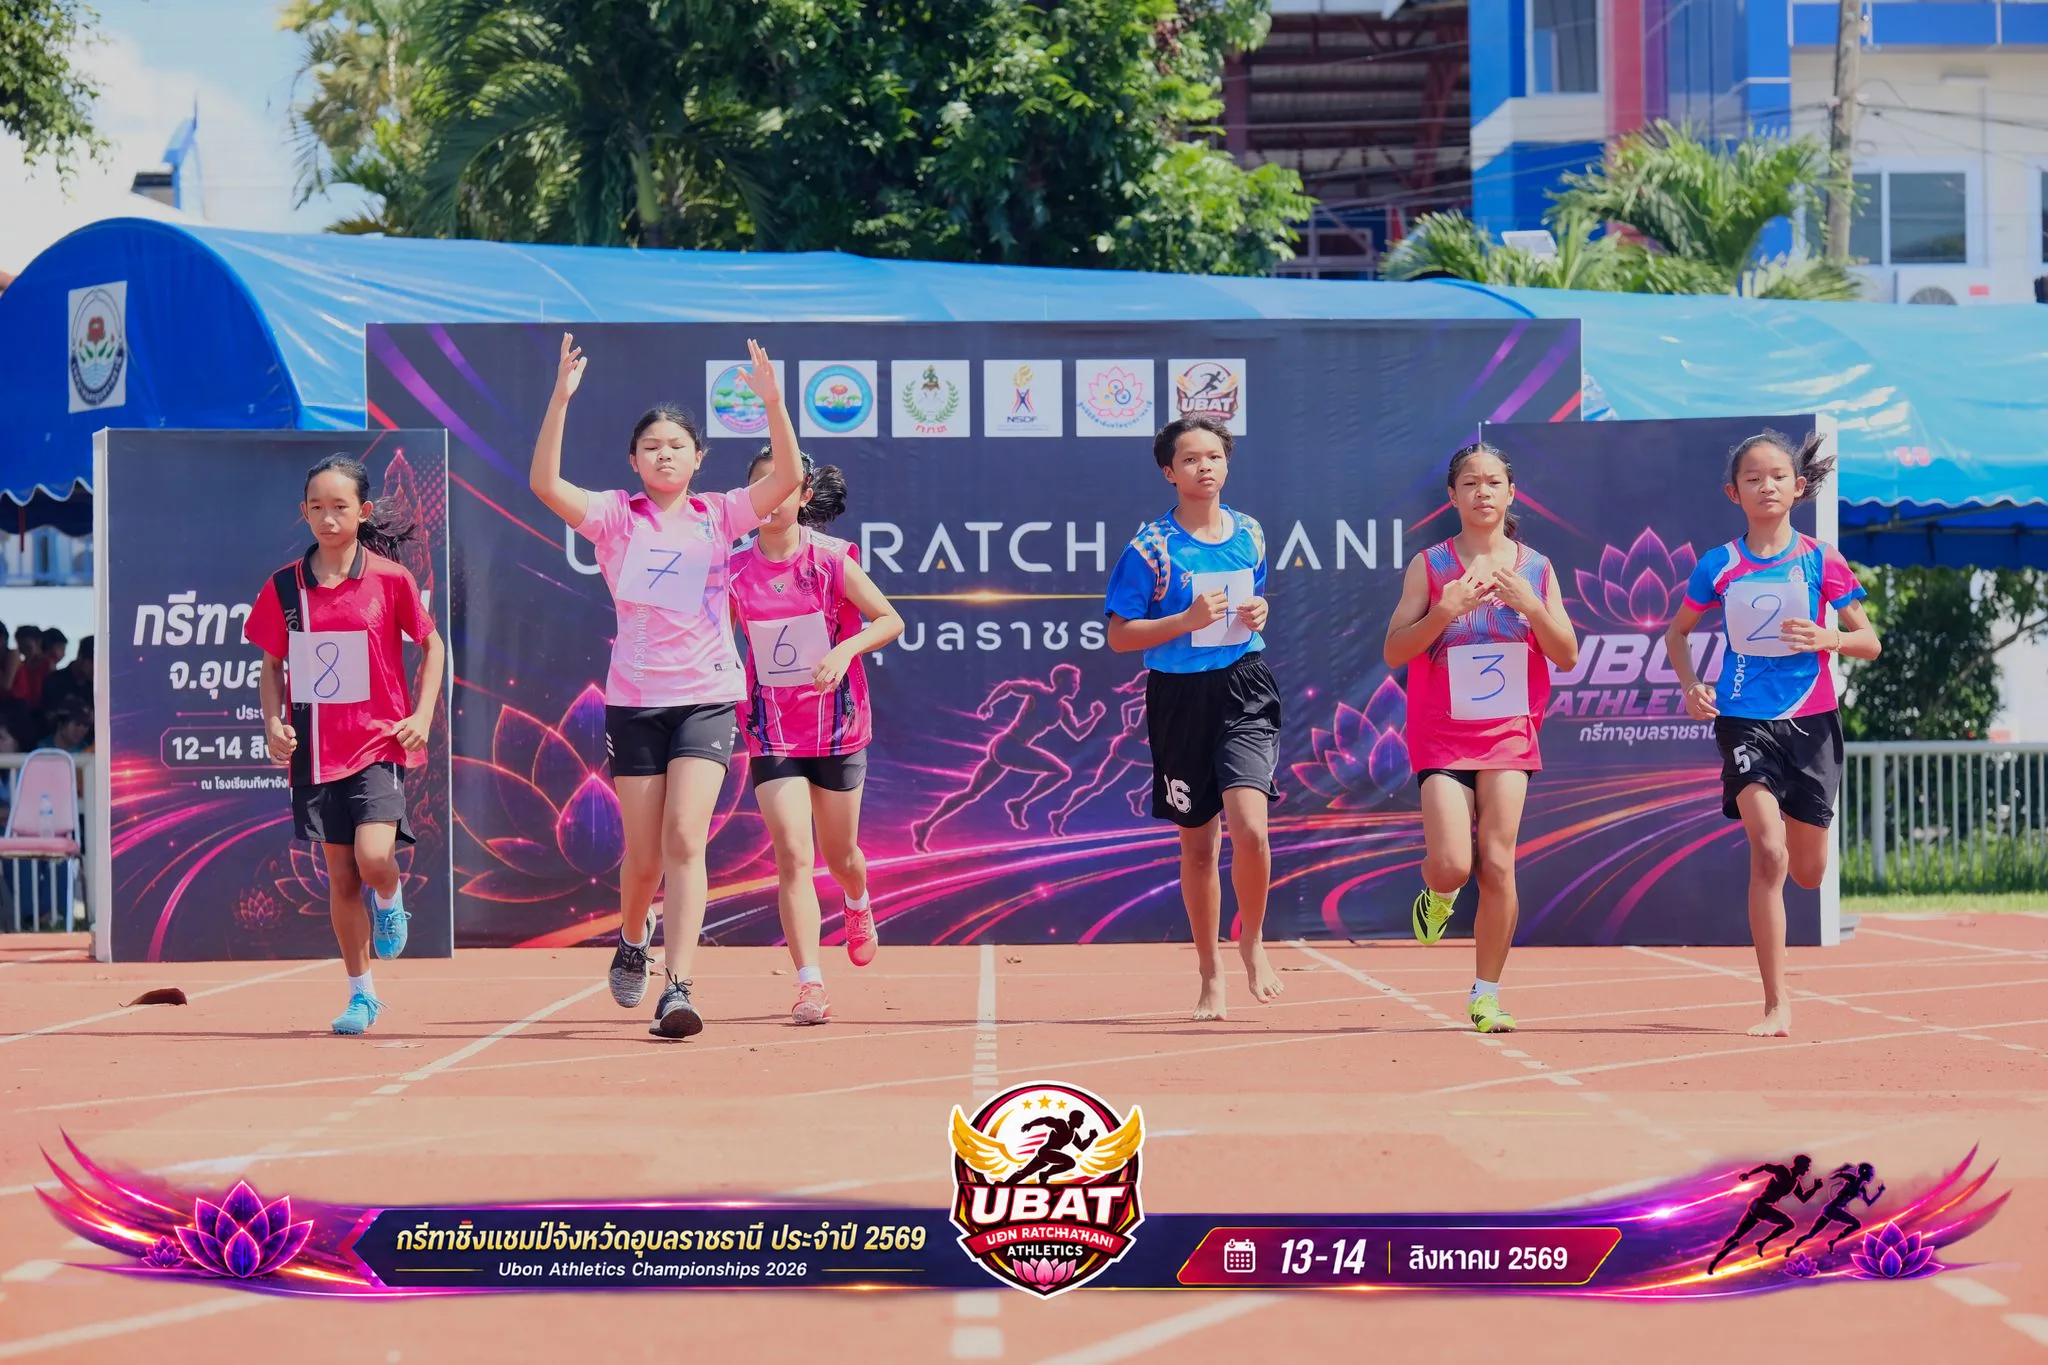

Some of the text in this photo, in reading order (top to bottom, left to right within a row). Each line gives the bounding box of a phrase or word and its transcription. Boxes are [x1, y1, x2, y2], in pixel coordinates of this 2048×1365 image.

[1181, 397, 1235, 412] UBAT
[647, 548, 682, 589] 7
[1746, 594, 1782, 642] 2
[773, 625, 798, 668] 6
[313, 641, 341, 698] 8
[1472, 654, 1506, 701] 3
[1729, 654, 1747, 700] CHOOL
[1733, 744, 1751, 775] 5
[1164, 774, 1192, 814] 16
